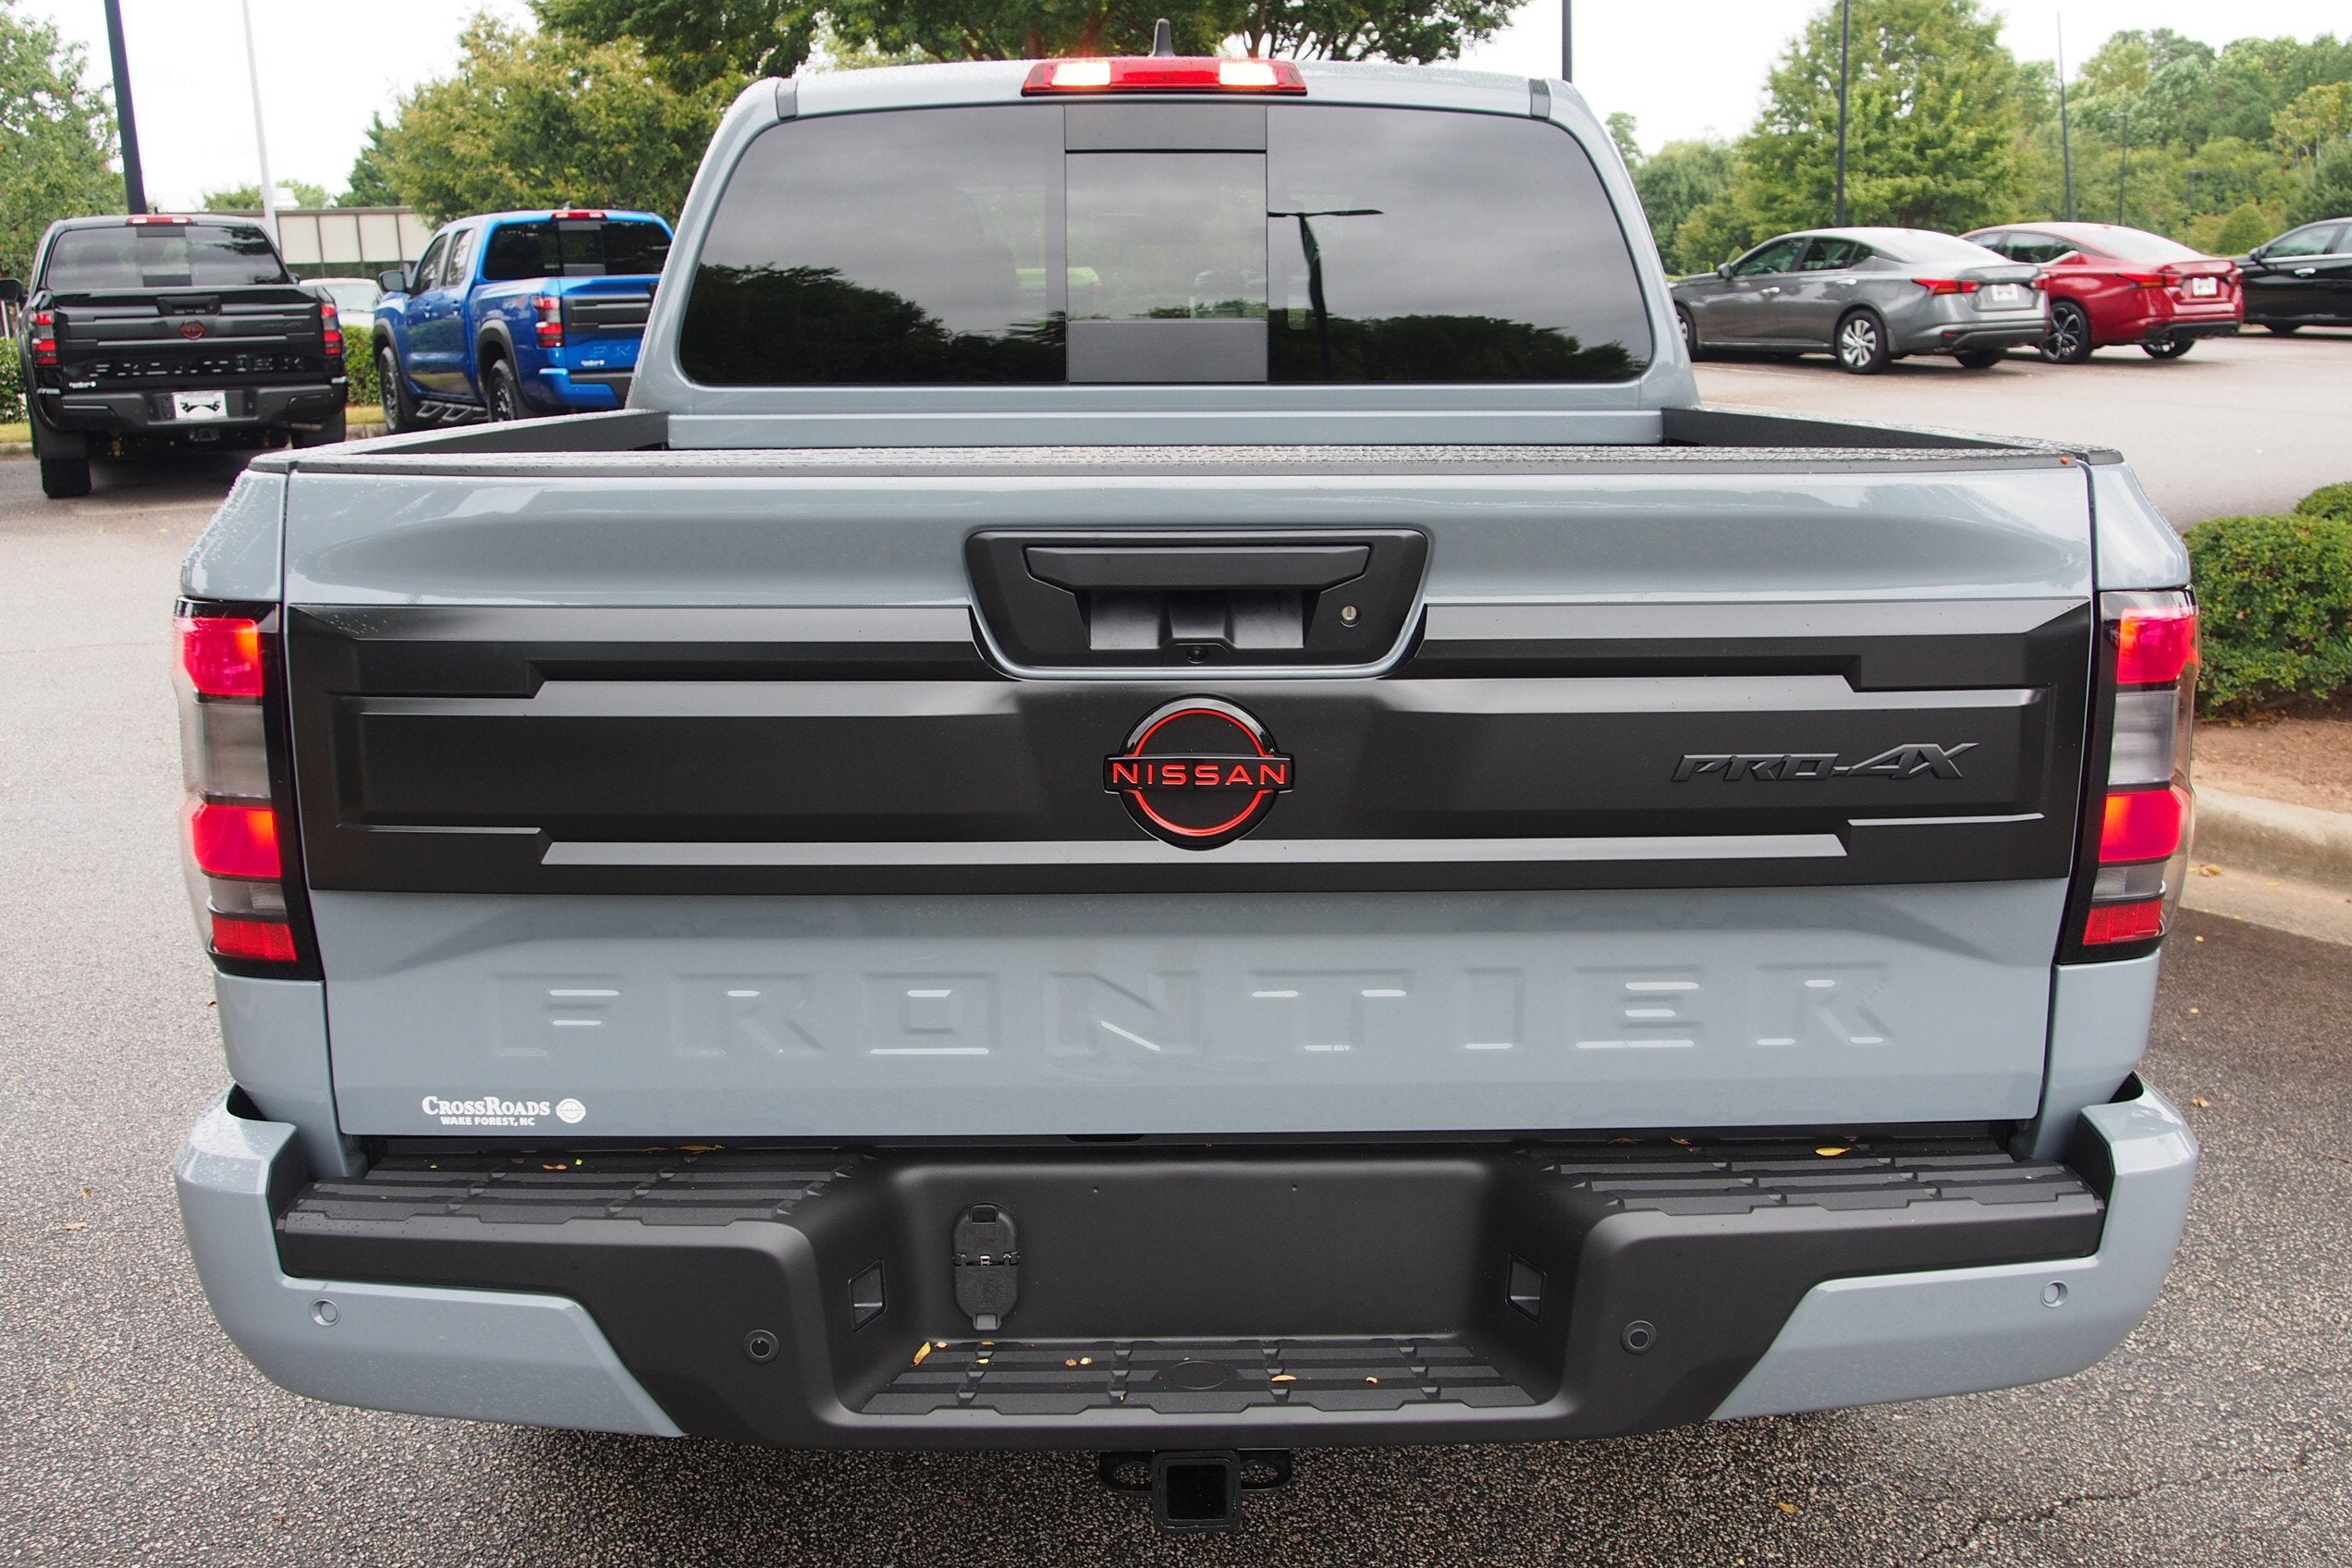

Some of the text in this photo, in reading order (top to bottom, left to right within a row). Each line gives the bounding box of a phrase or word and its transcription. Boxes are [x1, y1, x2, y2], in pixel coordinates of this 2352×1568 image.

[1112, 763, 1286, 786] NISSAN
[1671, 741, 1979, 782] PRO-4X
[490, 960, 1897, 1057] FRONTIER
[440, 1116, 535, 1127] WAKE FOREST, NC
